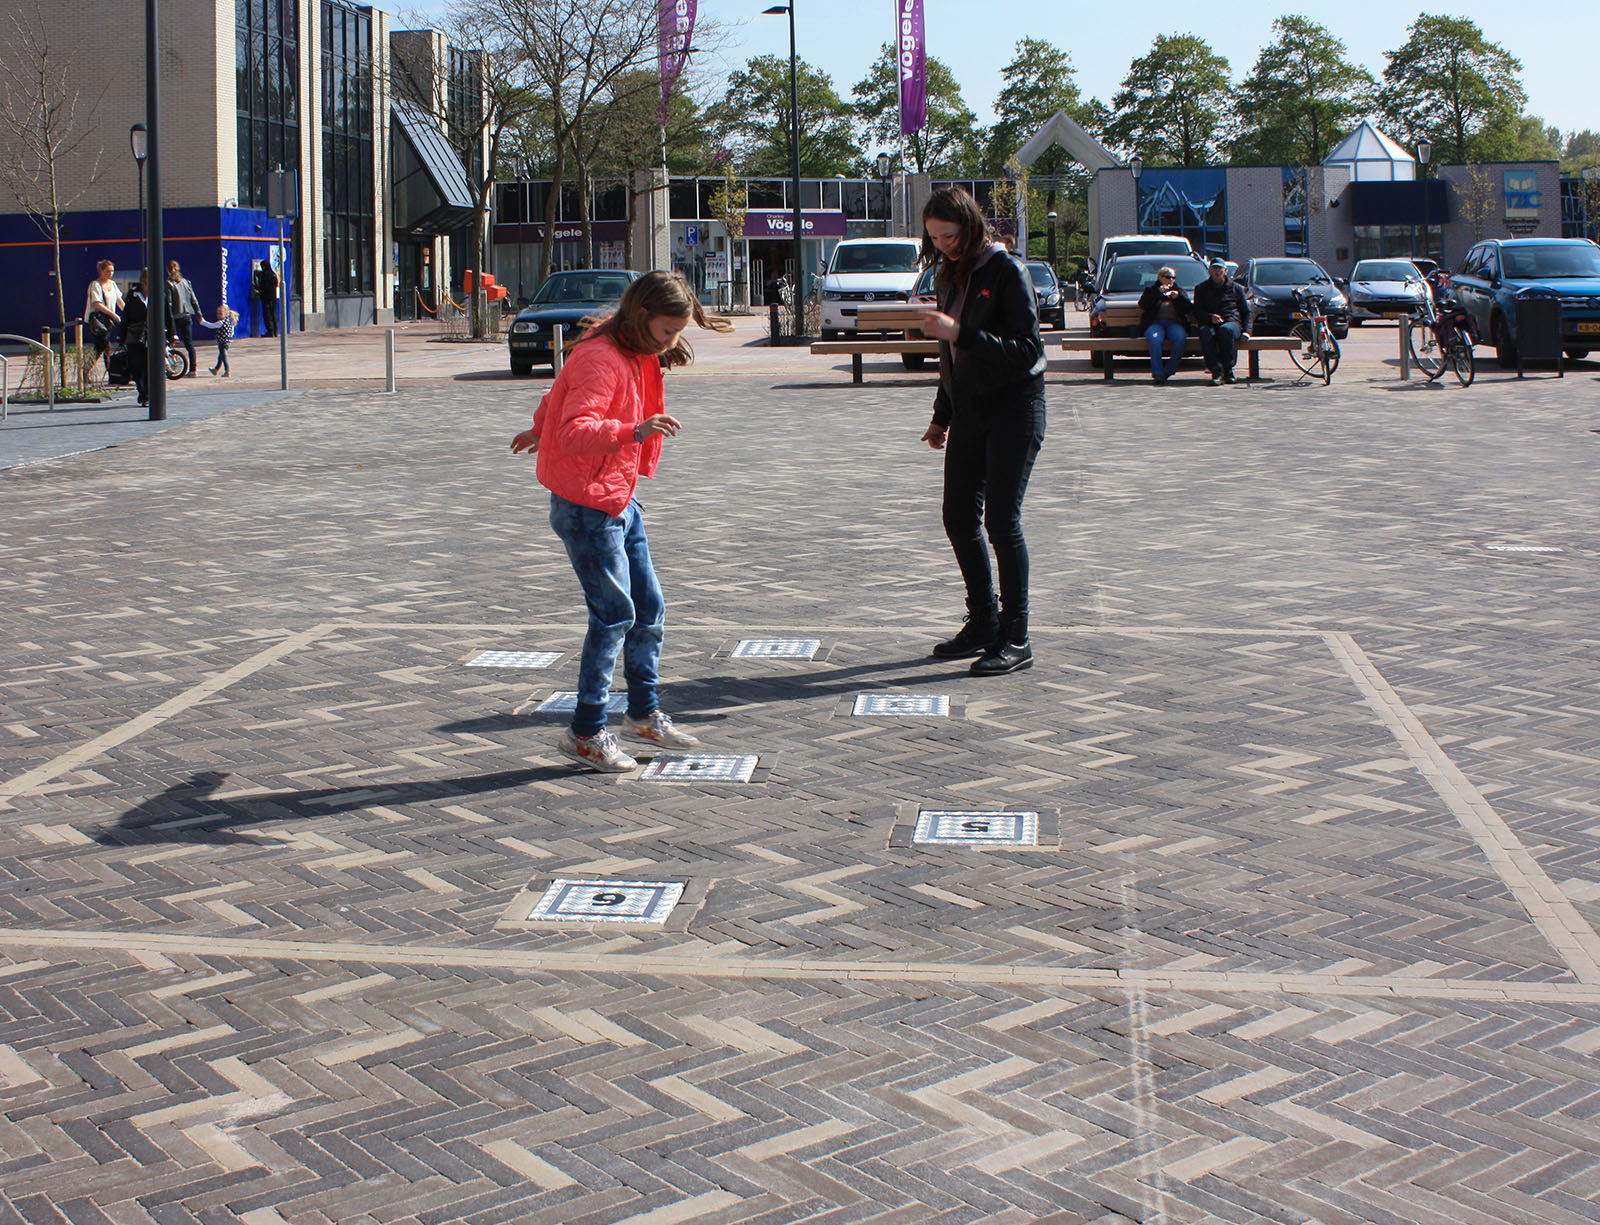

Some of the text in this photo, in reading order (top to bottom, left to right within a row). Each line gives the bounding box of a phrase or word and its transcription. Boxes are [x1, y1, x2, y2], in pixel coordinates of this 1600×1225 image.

[767, 218, 814, 232] Vögle
[538, 228, 583, 239] Vgele
[687, 226, 696, 237] P
[961, 821, 990, 833] 5
